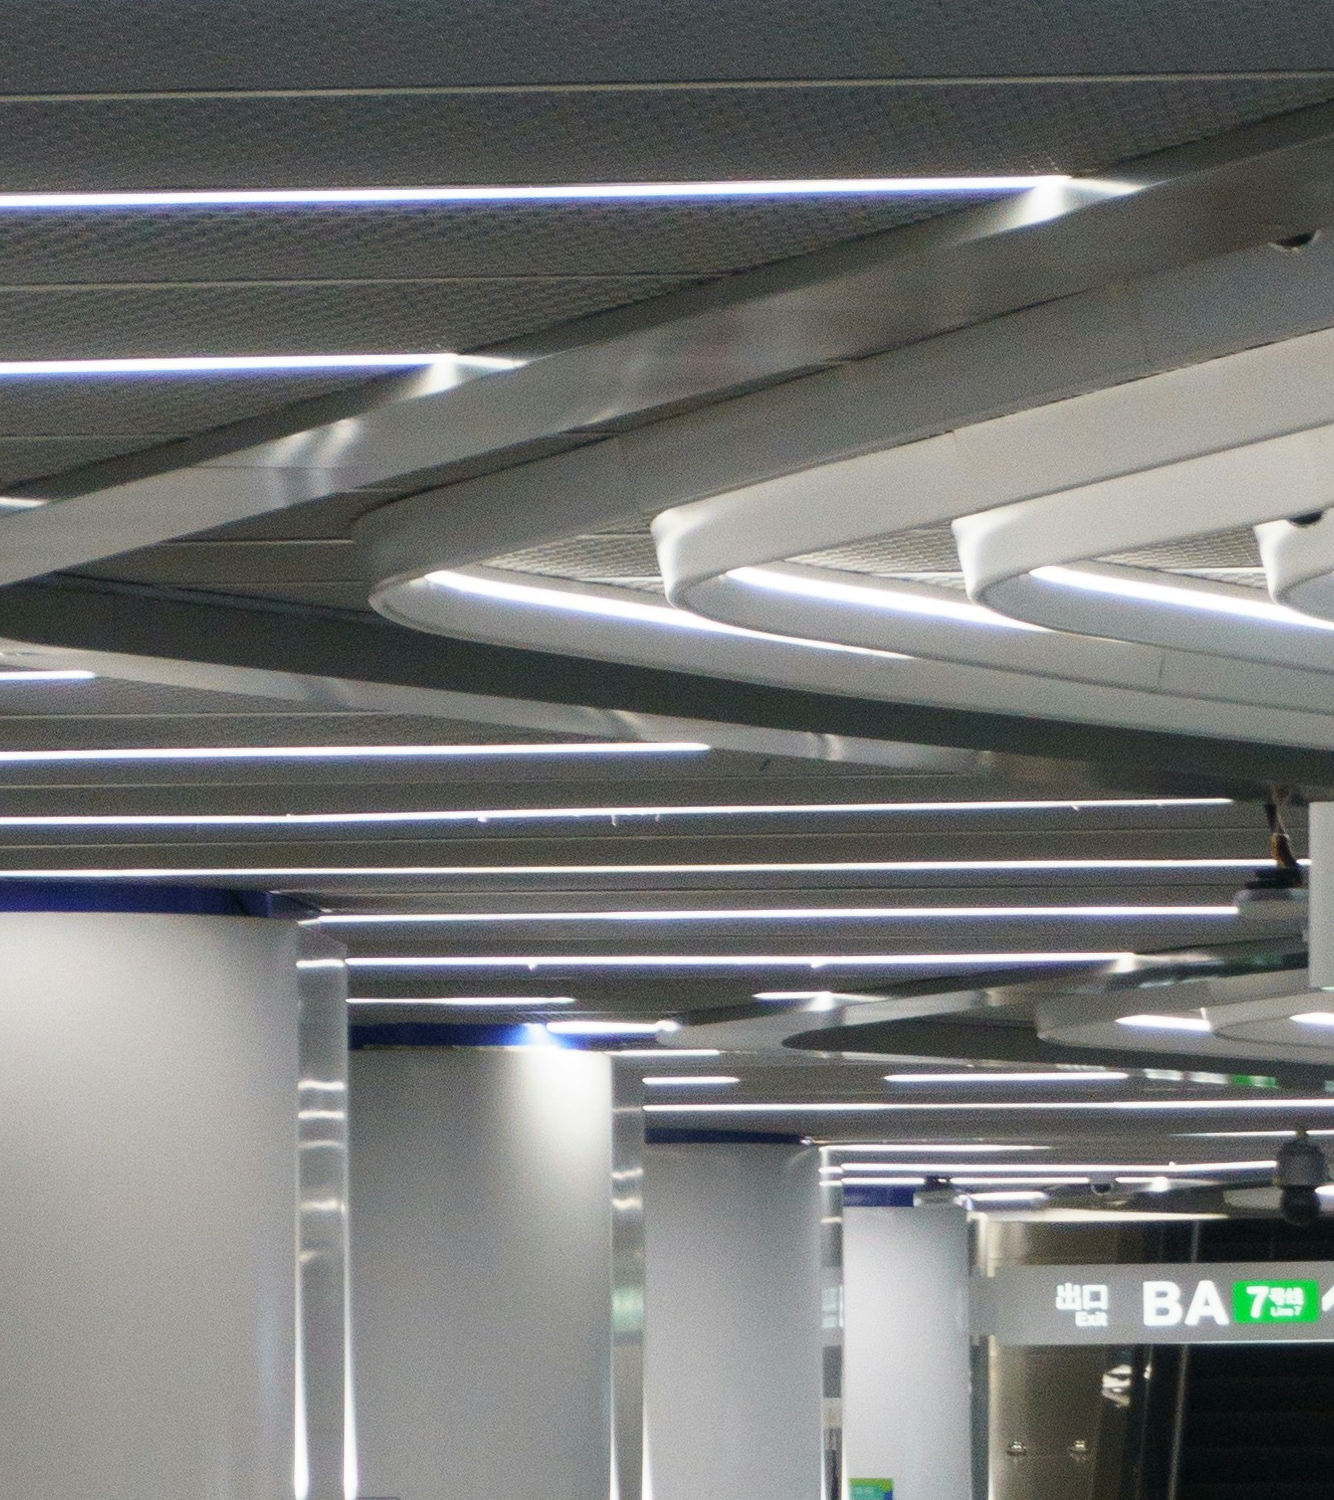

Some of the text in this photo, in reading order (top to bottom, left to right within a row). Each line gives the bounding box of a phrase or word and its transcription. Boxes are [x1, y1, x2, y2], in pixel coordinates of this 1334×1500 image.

[1055, 1282, 1109, 1312] 出口
[1142, 1280, 1230, 1326] BA
[1075, 1311, 1109, 1328] Exit
